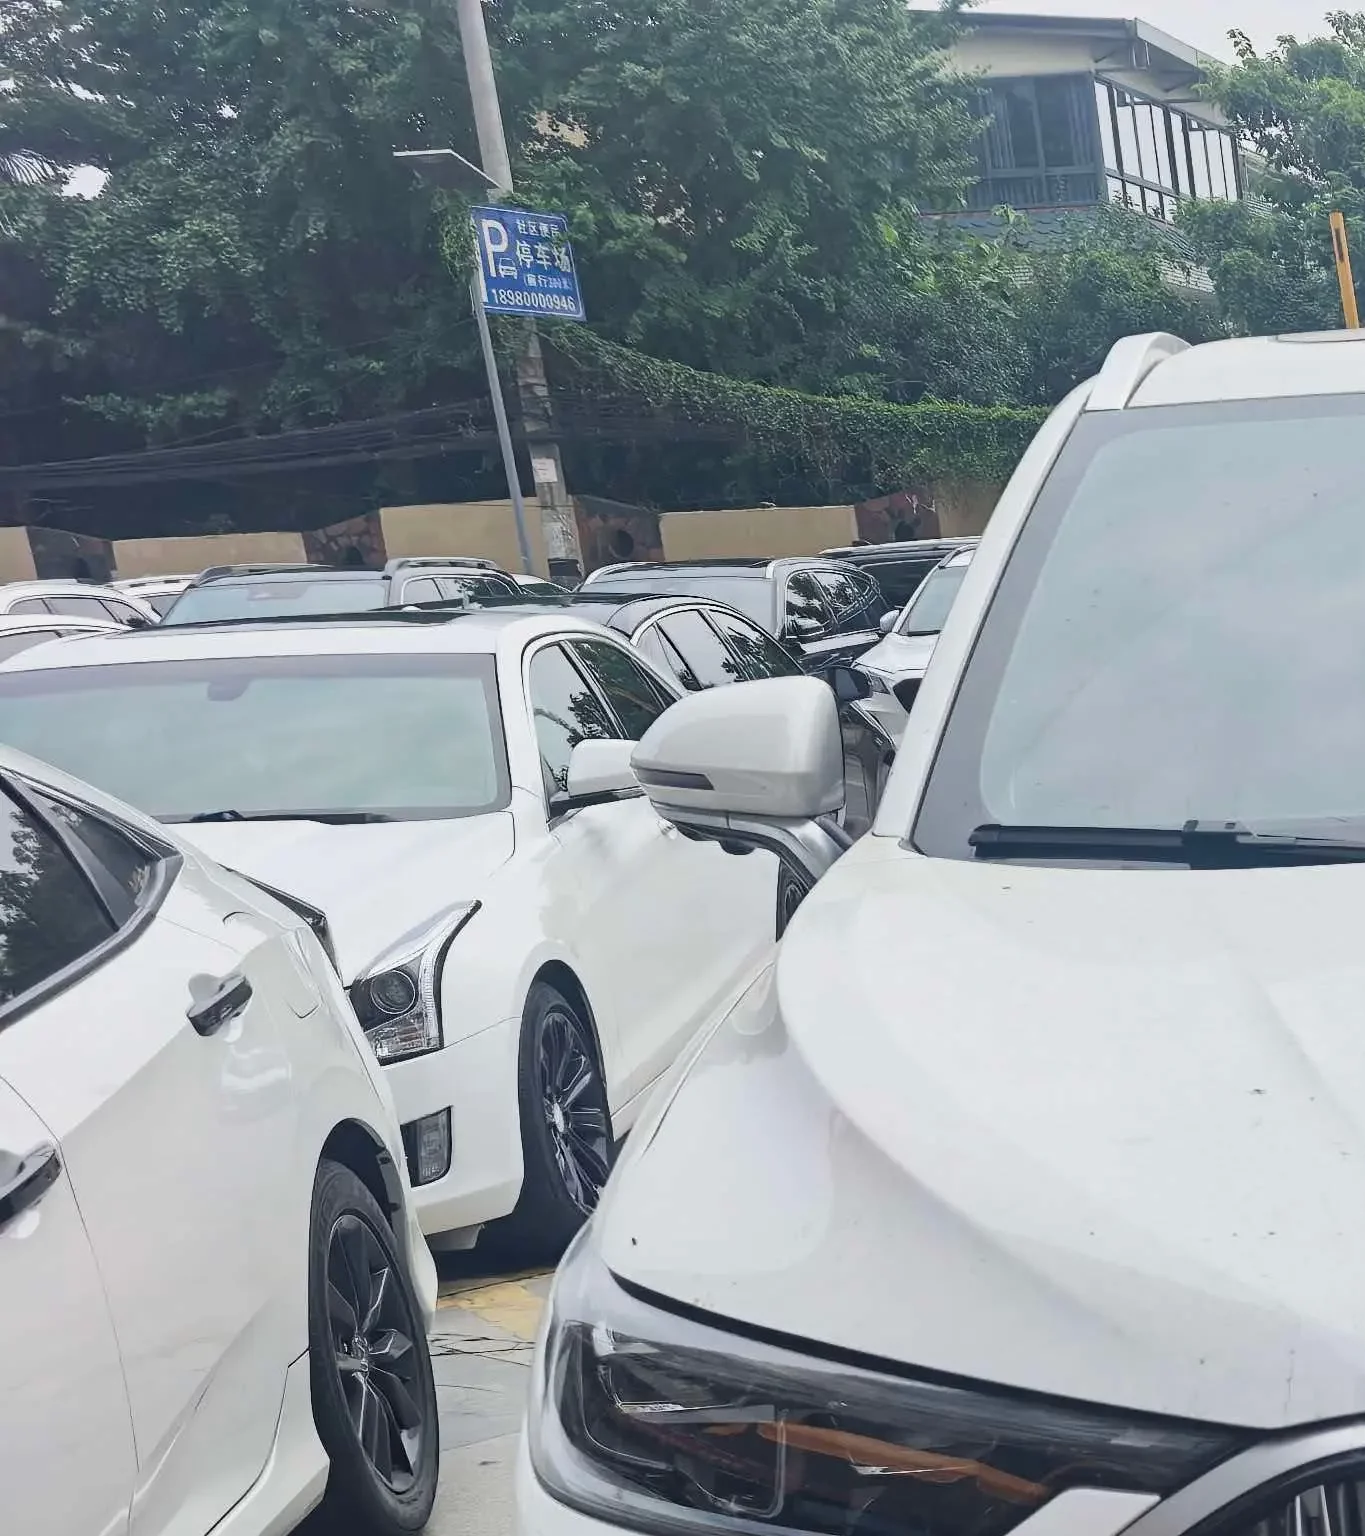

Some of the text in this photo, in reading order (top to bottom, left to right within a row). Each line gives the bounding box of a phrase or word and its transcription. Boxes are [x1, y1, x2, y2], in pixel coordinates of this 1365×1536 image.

[481, 218, 509, 278] P
[516, 240, 571, 273] 停车场
[491, 289, 577, 312] 18980000946
